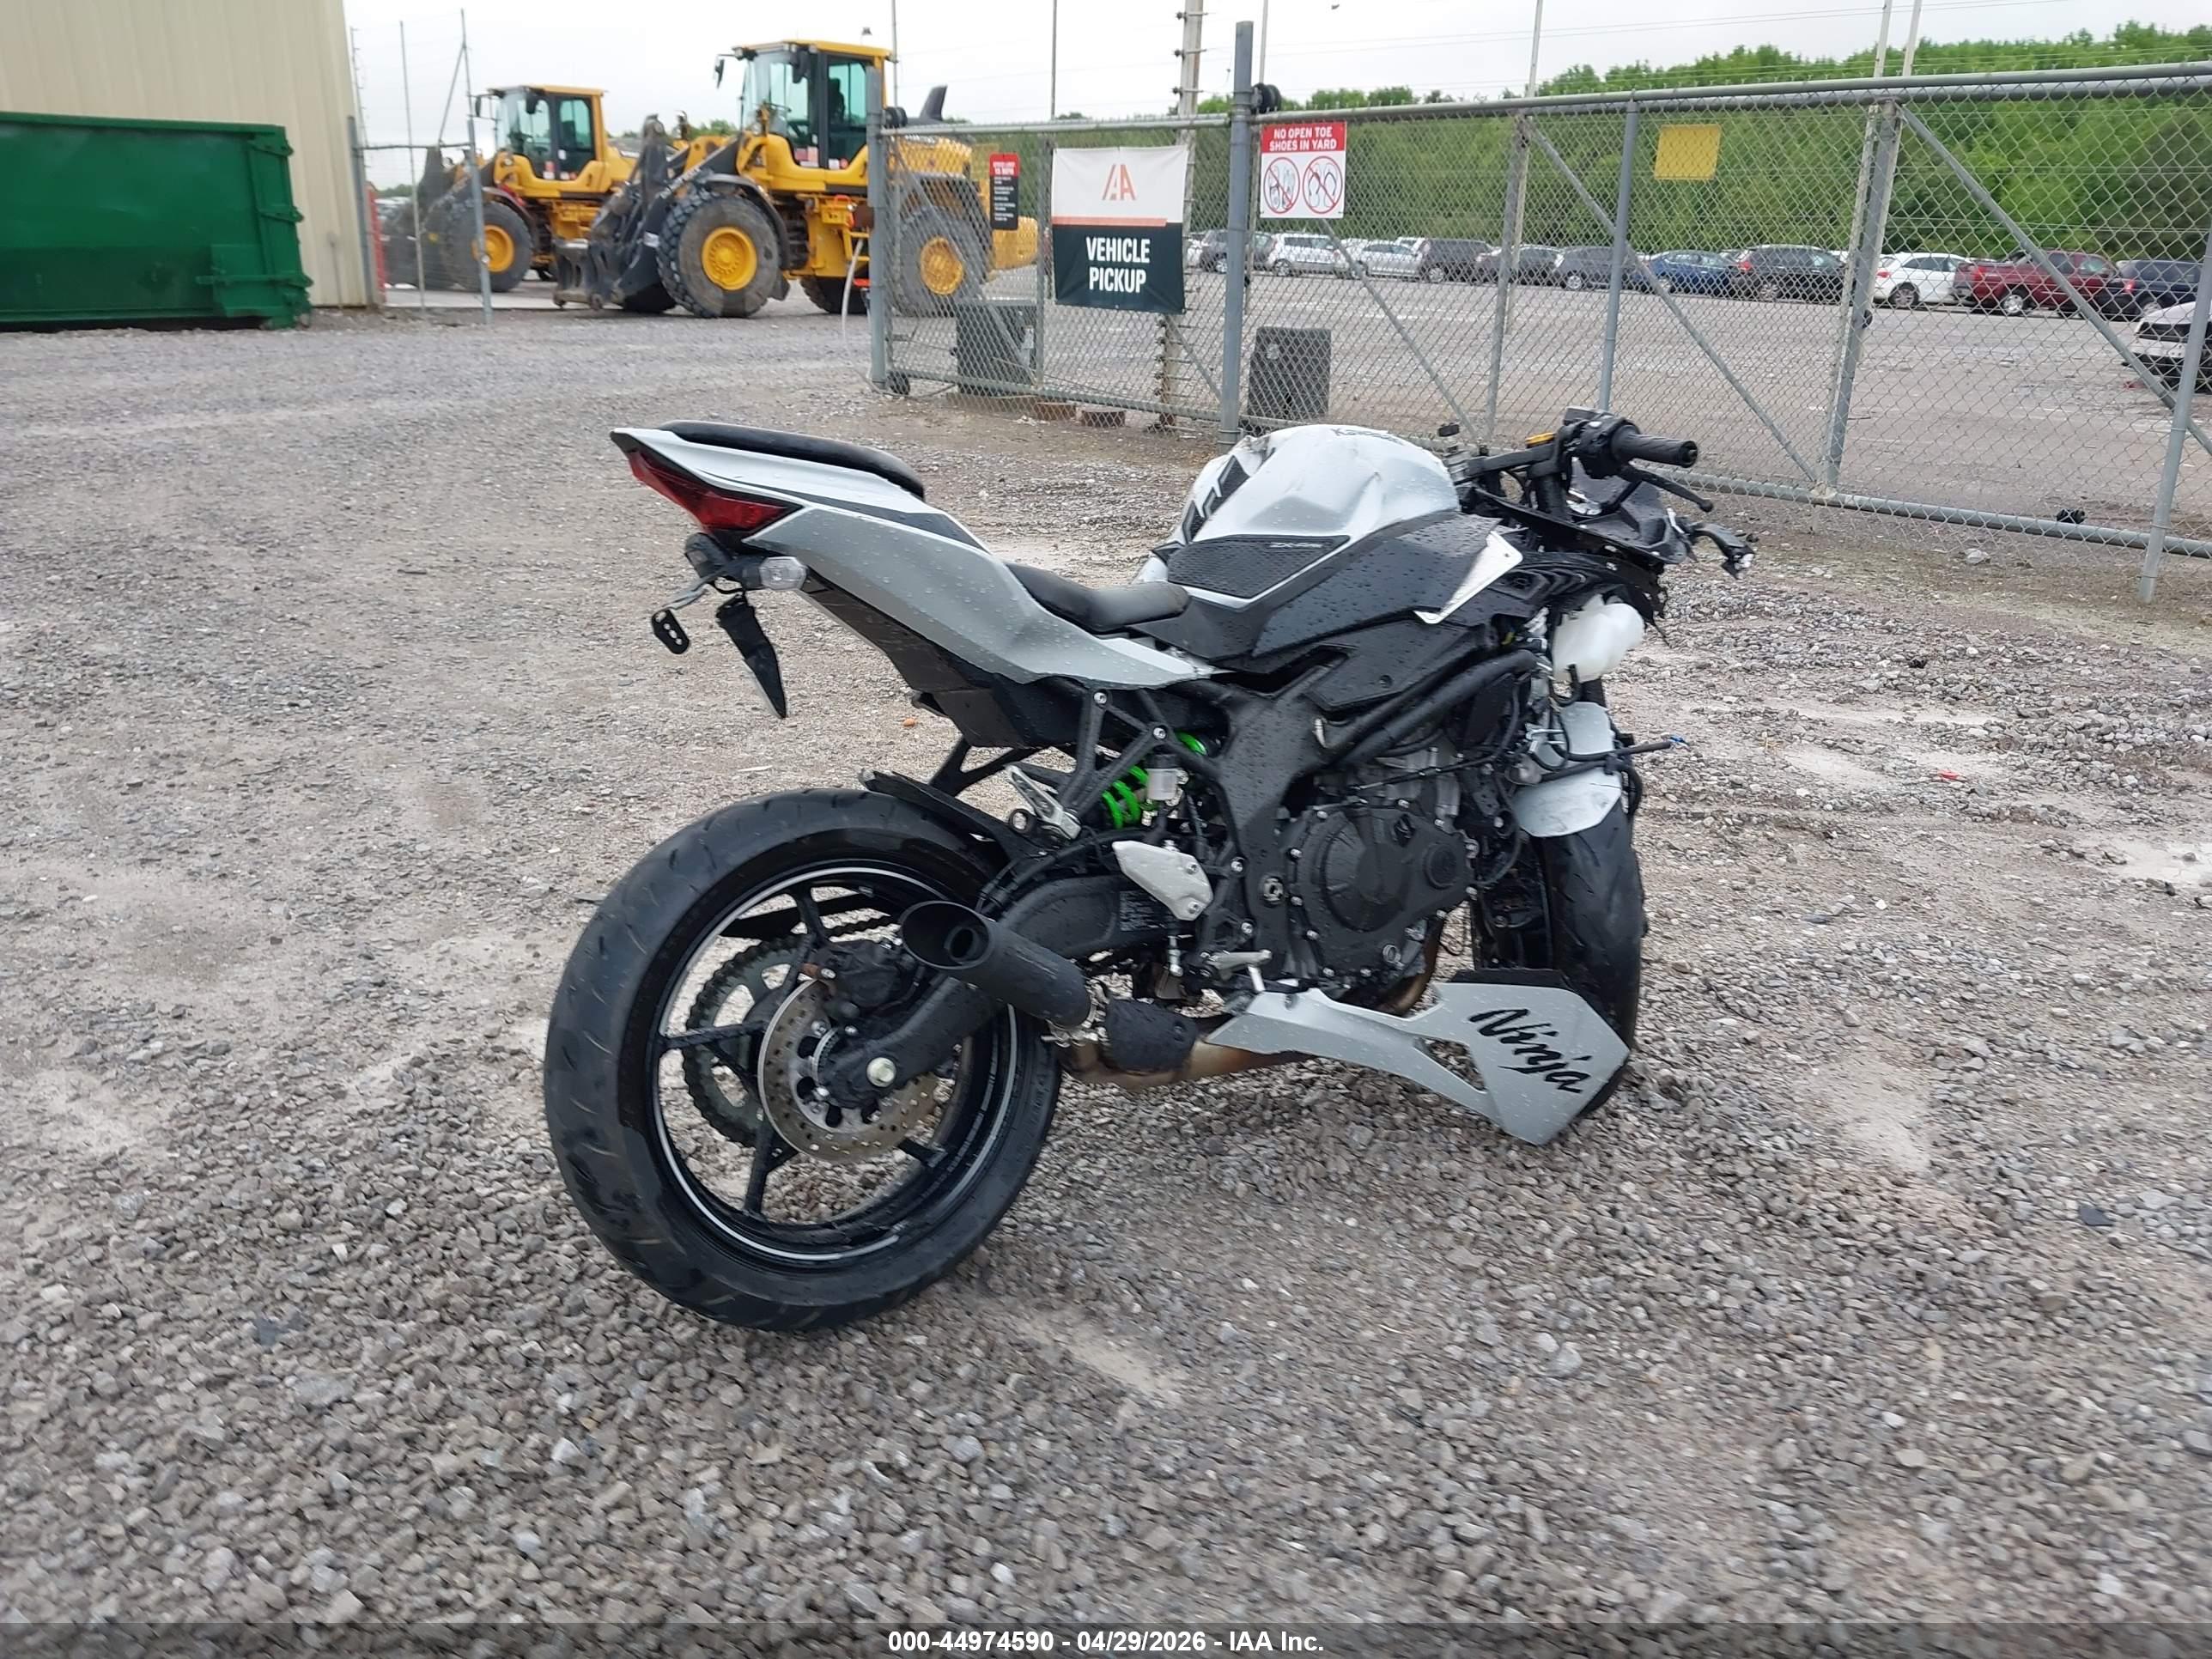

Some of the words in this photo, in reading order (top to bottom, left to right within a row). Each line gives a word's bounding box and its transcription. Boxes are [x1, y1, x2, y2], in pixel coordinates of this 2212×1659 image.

[1269, 139, 1297, 151] SHOES
[1299, 139, 1310, 150] IN
[1311, 138, 1337, 149] YARD
[1273, 128, 1286, 139] NO
[1288, 127, 1313, 138] OPEN
[1315, 126, 1333, 137] TOE
[1085, 236, 1151, 264] VEHICLE
[1089, 266, 1146, 293] PICKUP
[1468, 1008, 1594, 1094] Ninja
